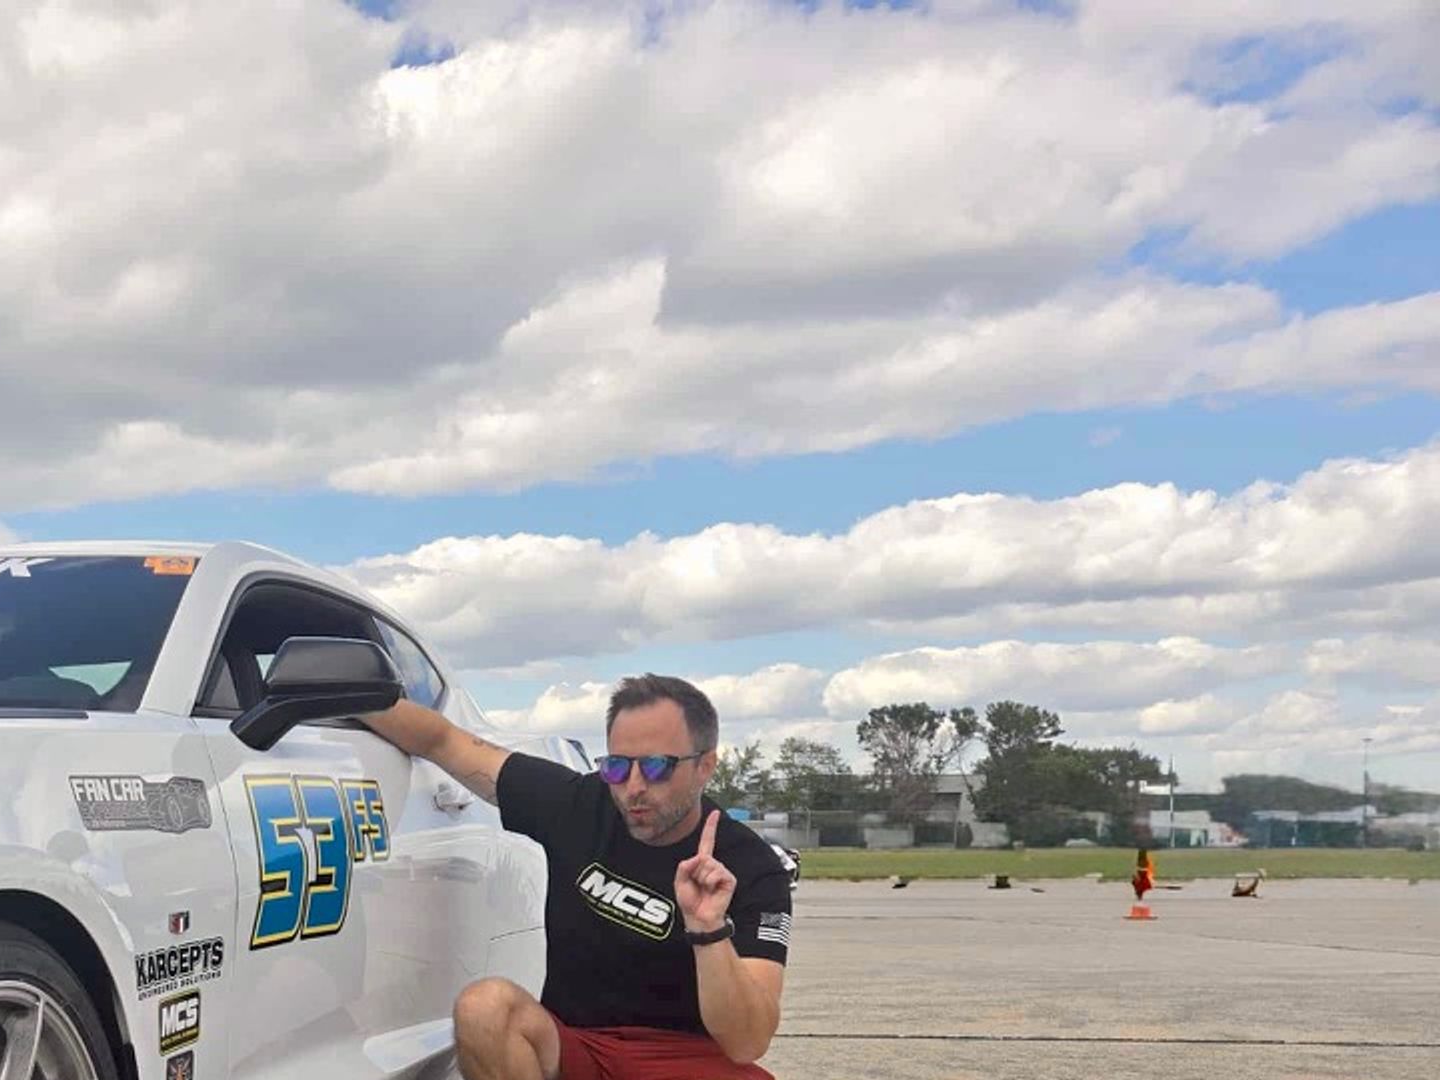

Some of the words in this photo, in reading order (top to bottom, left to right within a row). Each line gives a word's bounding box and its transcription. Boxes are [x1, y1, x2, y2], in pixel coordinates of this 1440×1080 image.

[71, 779, 111, 801] FAN
[111, 779, 146, 801] CAR
[243, 774, 353, 951] 53
[580, 870, 671, 925] MCS
[135, 938, 224, 988] KARCEPTS
[161, 998, 199, 1038] MCS
